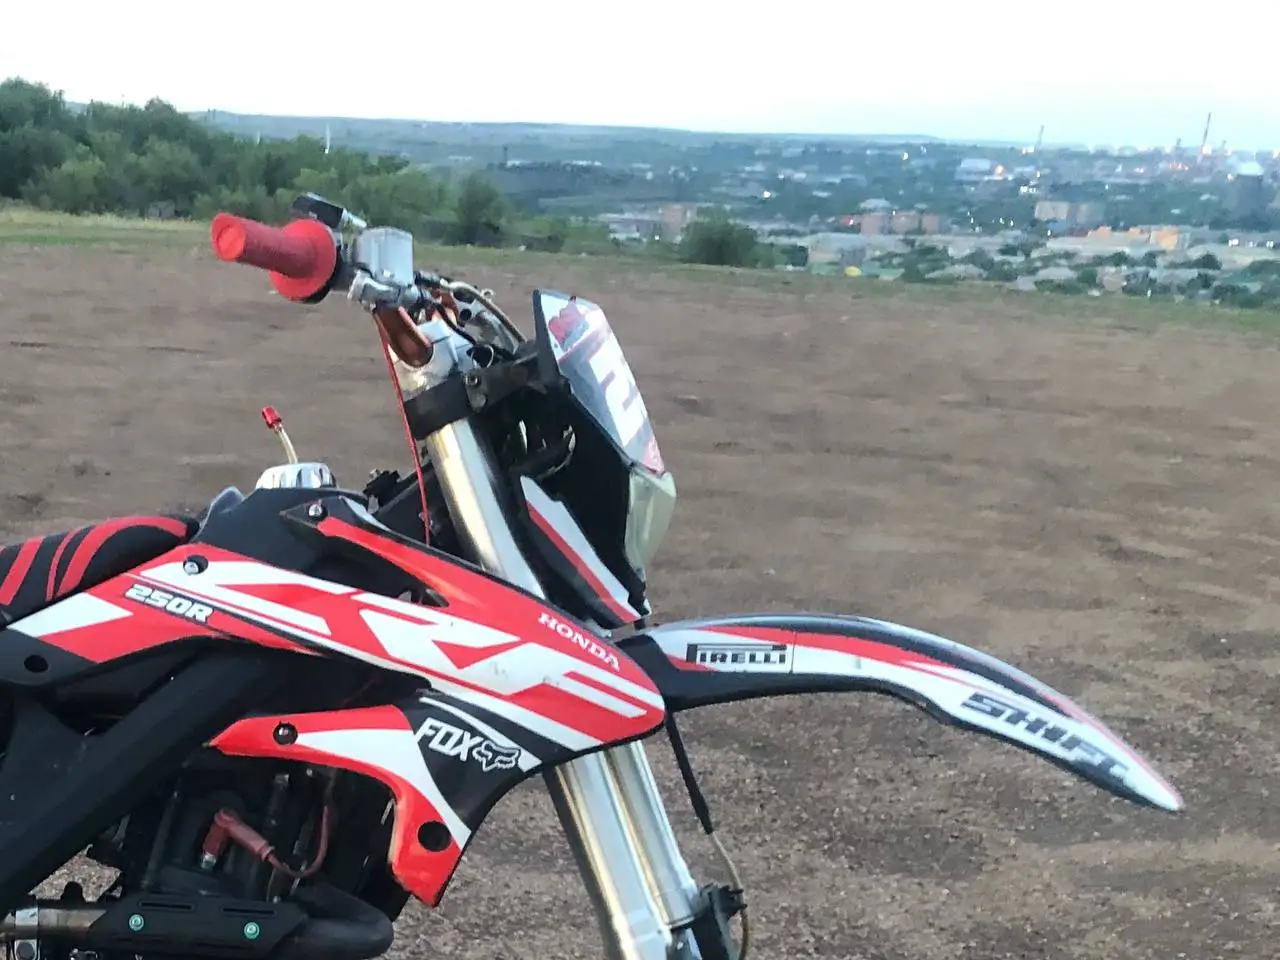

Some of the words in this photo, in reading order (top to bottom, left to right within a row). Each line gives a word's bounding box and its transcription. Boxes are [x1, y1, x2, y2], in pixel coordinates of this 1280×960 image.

[124, 583, 215, 625] 250R
[538, 611, 620, 671] HONDA
[685, 643, 787, 664] PIRELLI
[414, 717, 484, 762] FOX
[960, 692, 1129, 774] SHIFT
